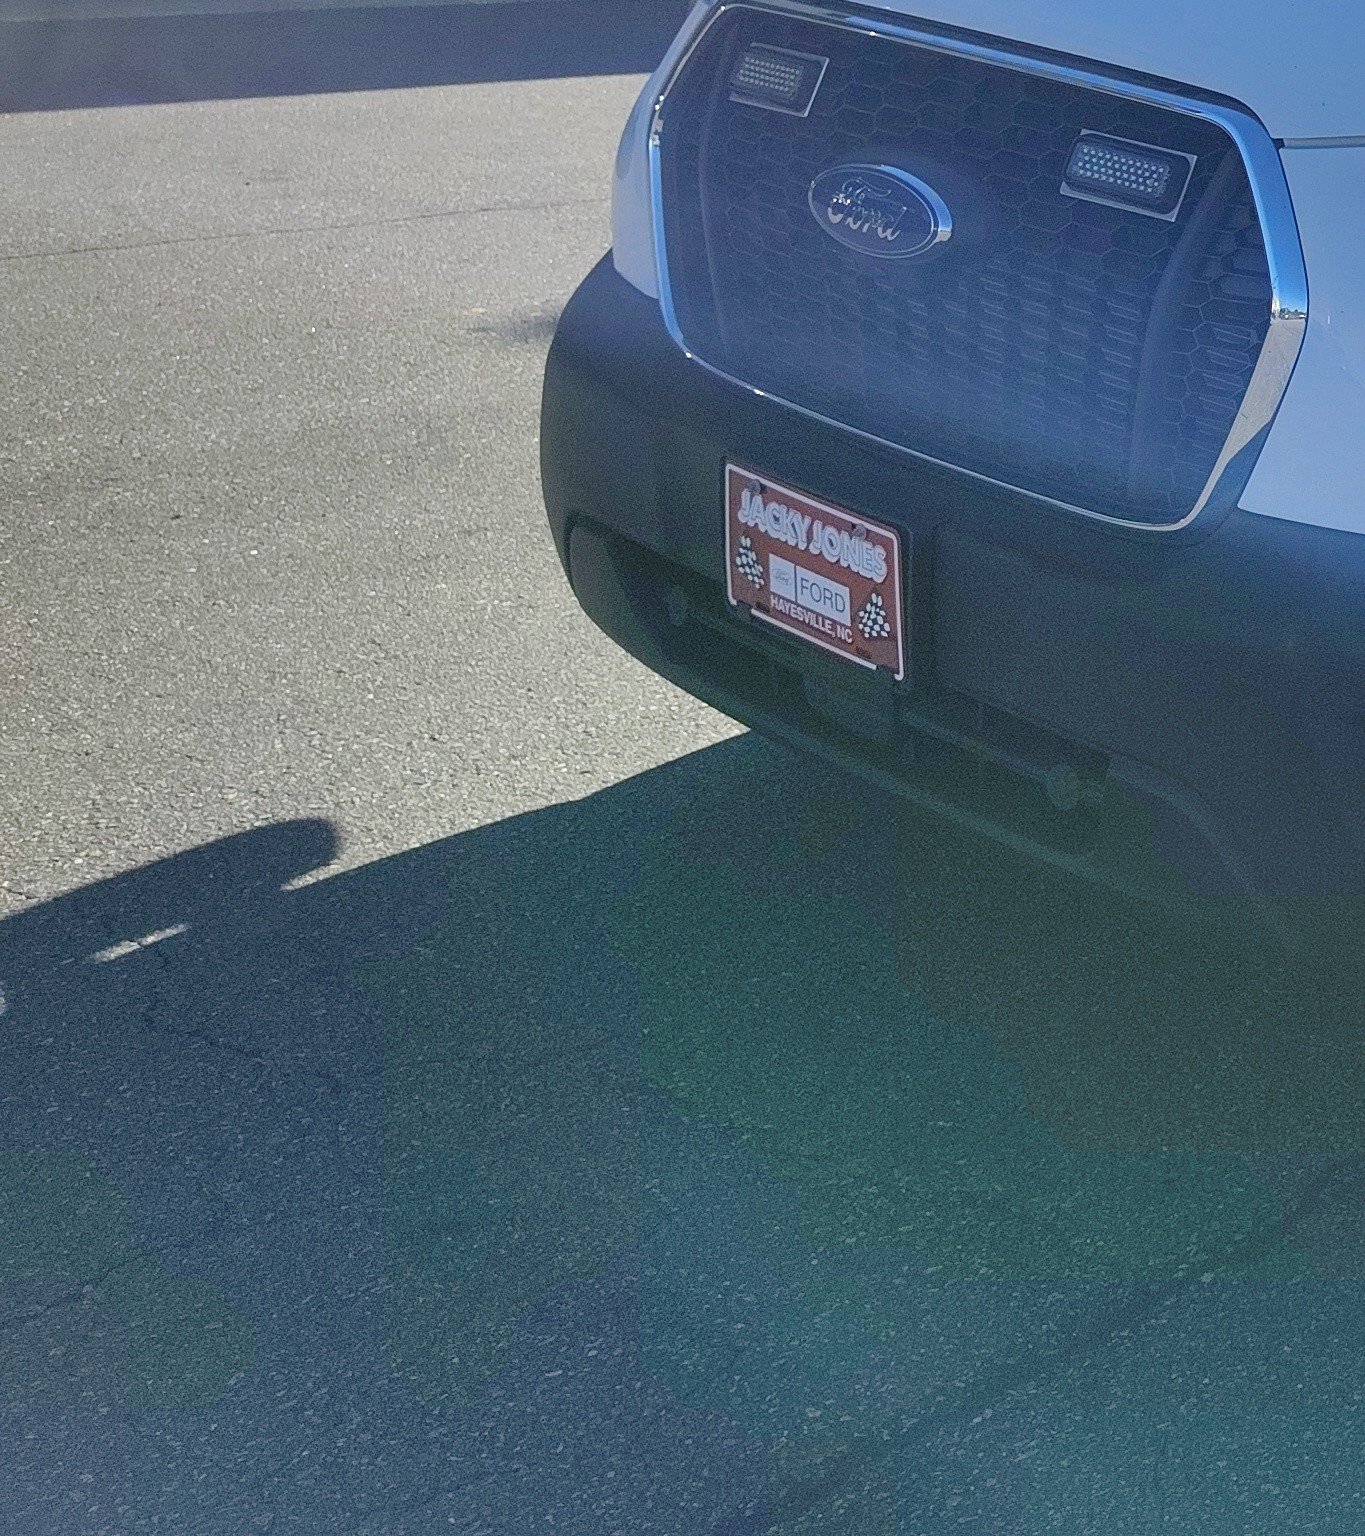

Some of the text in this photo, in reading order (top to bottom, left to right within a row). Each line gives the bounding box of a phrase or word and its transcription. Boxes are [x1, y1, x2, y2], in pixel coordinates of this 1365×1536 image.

[827, 177, 908, 241] Ford
[737, 488, 888, 584] JACKY JONES
[770, 594, 854, 644] HAYESVILLE, NC
[800, 577, 846, 613] FORD
